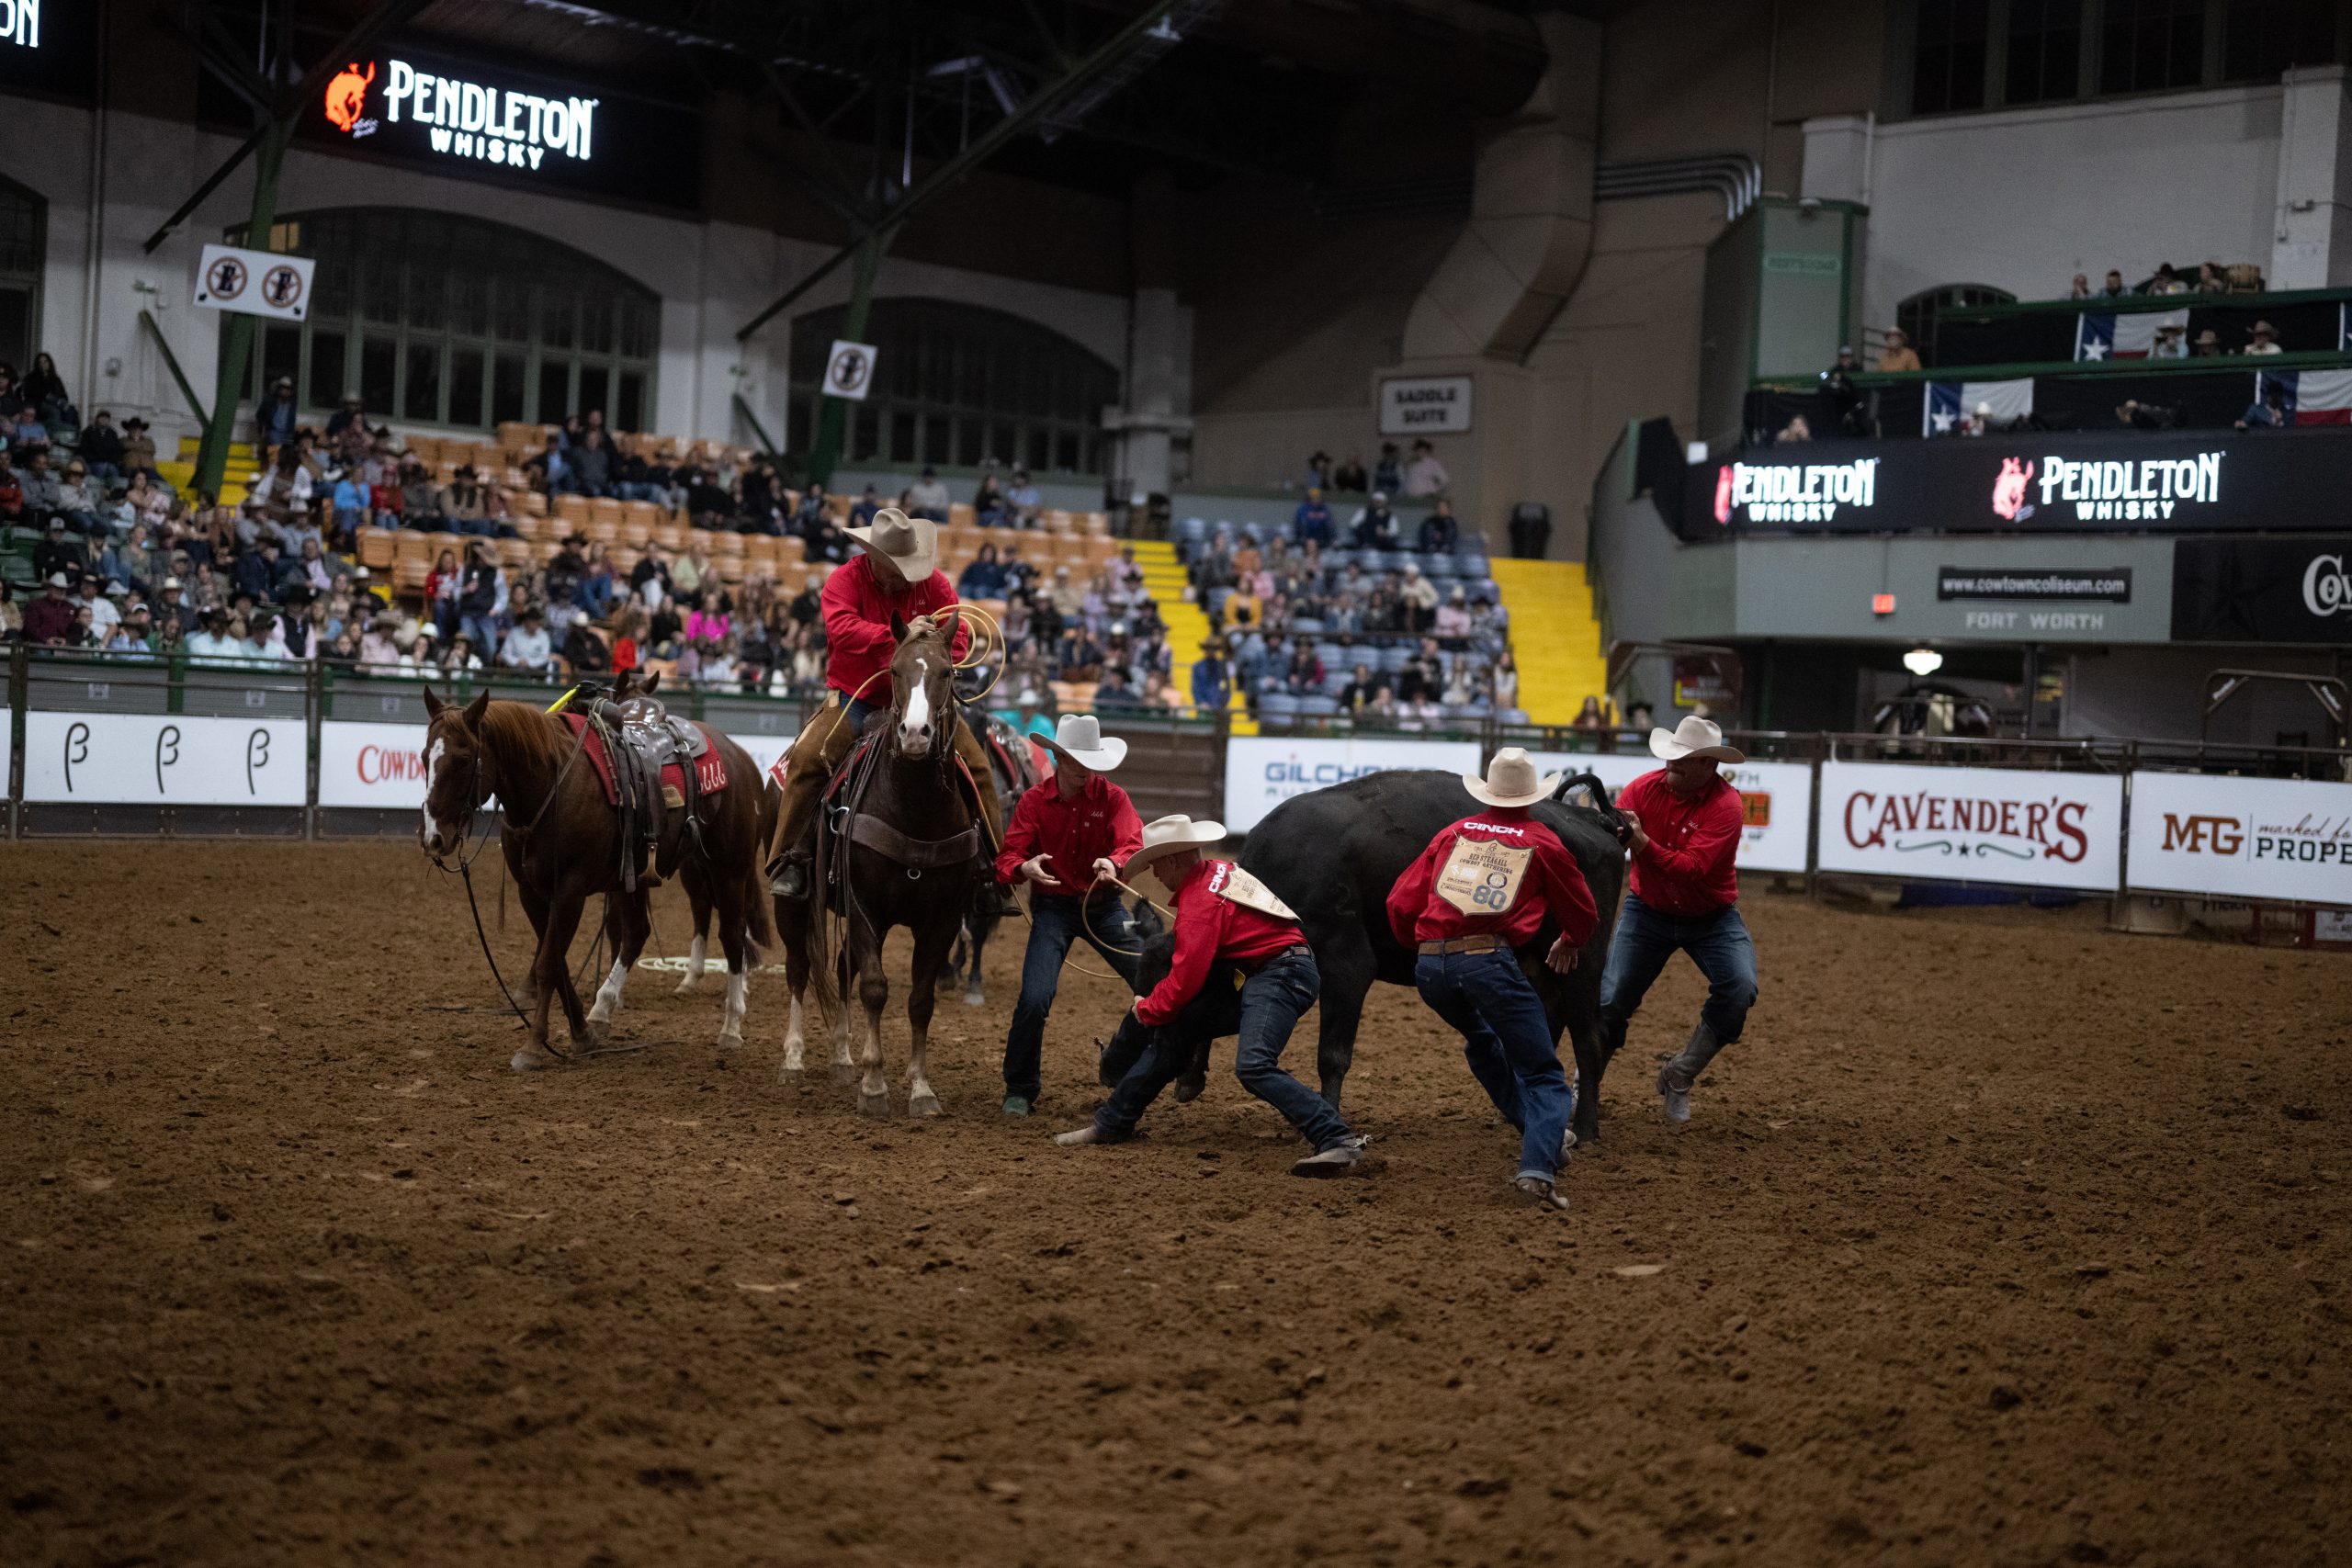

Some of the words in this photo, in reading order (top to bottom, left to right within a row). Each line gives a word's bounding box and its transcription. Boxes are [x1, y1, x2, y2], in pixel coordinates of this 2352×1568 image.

[383, 60, 595, 161] PENDLETON
[430, 127, 545, 171] WHISKY
[1731, 458, 1876, 508] PENDLETON
[2038, 453, 2221, 505] PENDLETON
[1748, 502, 1837, 522] WHISKY
[2075, 501, 2175, 520] WHISKY
[1942, 575, 2126, 593] www.cowtowncoliseum.com
[1966, 611, 2018, 628] FORT
[2029, 613, 2104, 630] WORTH
[1464, 821, 1524, 837] CINCH
[1843, 789, 2089, 863] CAVENDER'S
[2161, 811, 2245, 856] MFG
[2258, 814, 2332, 838] marked
[1479, 854, 1508, 867] STEAGALL
[1482, 863, 1513, 874] GATHERING
[1472, 885, 1507, 910] 80
